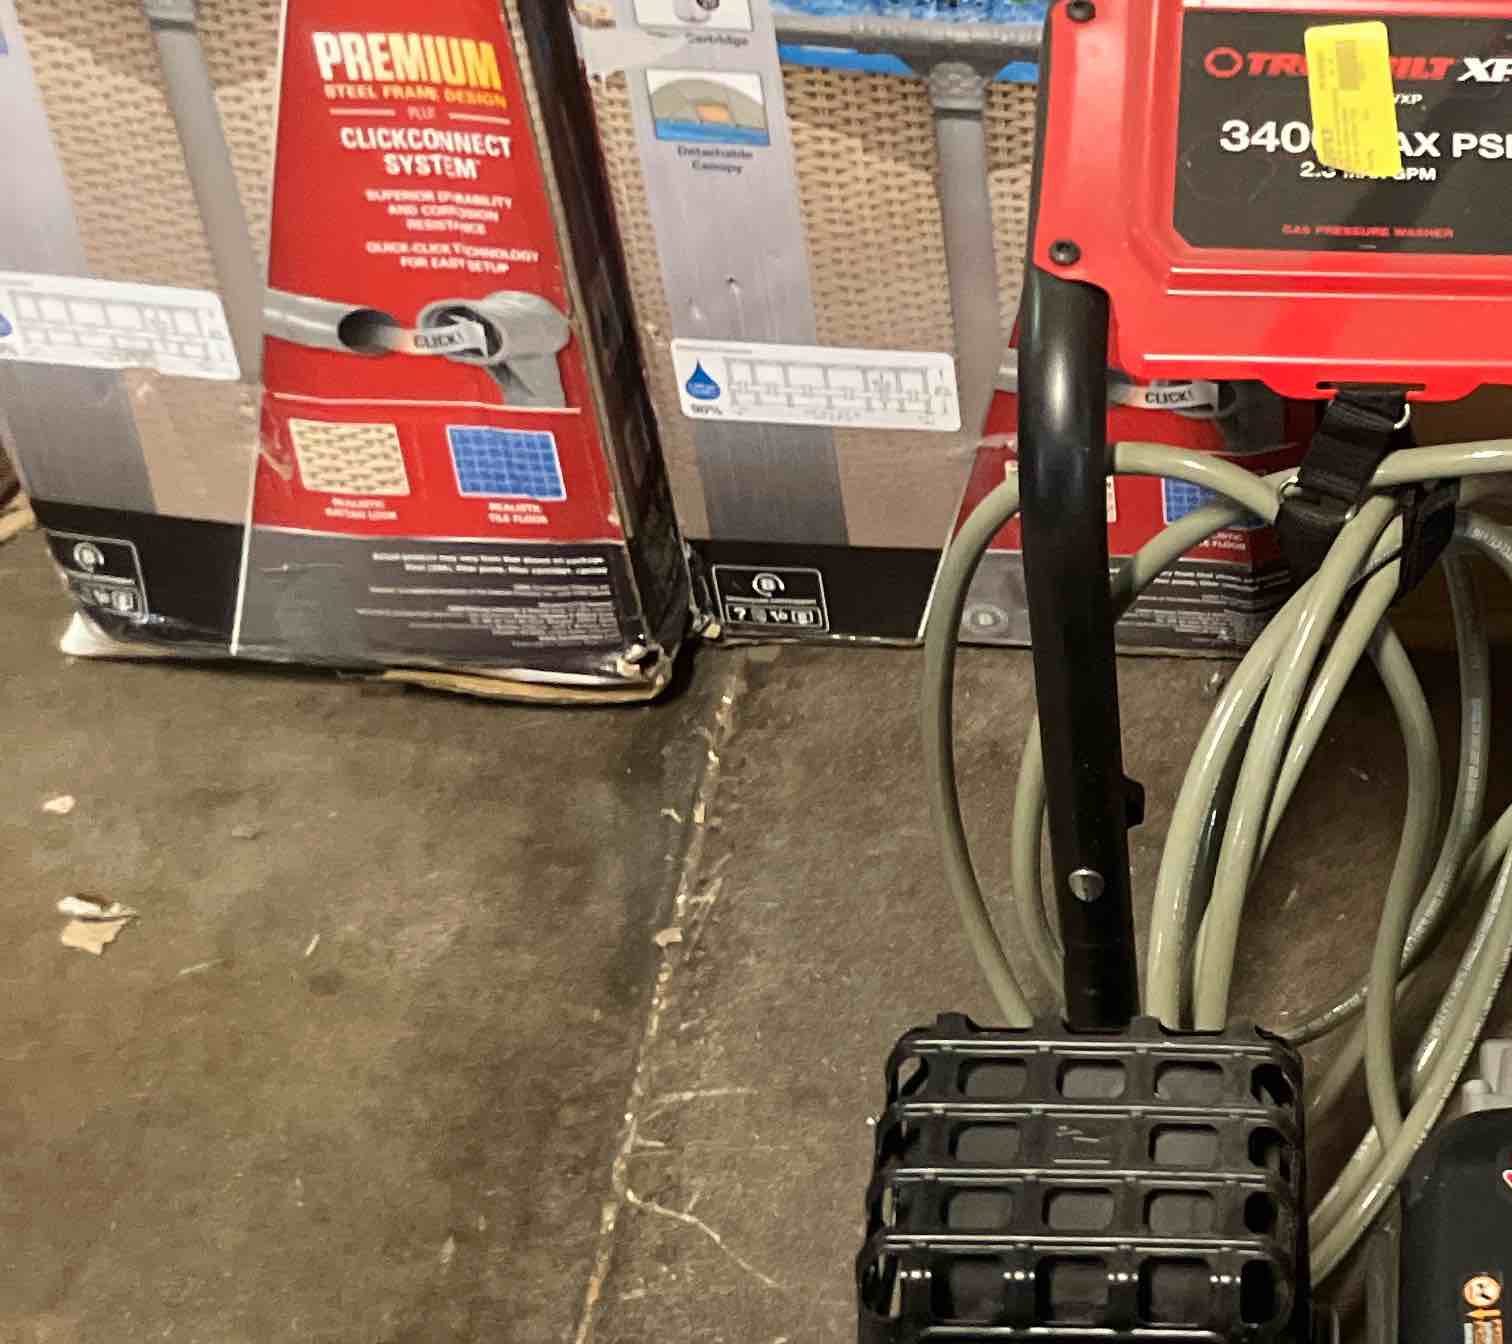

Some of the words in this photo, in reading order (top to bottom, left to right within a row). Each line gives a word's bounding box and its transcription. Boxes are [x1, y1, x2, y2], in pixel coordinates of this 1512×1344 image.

[311, 31, 502, 90] PREMIUM
[323, 83, 377, 101] STEEL
[443, 87, 508, 109] DESIGN
[340, 127, 512, 159] CLICKCONNECT
[1219, 119, 1319, 154] 340
[1396, 131, 1441, 157] AX
[1315, 225, 1390, 238] PRESSURE
